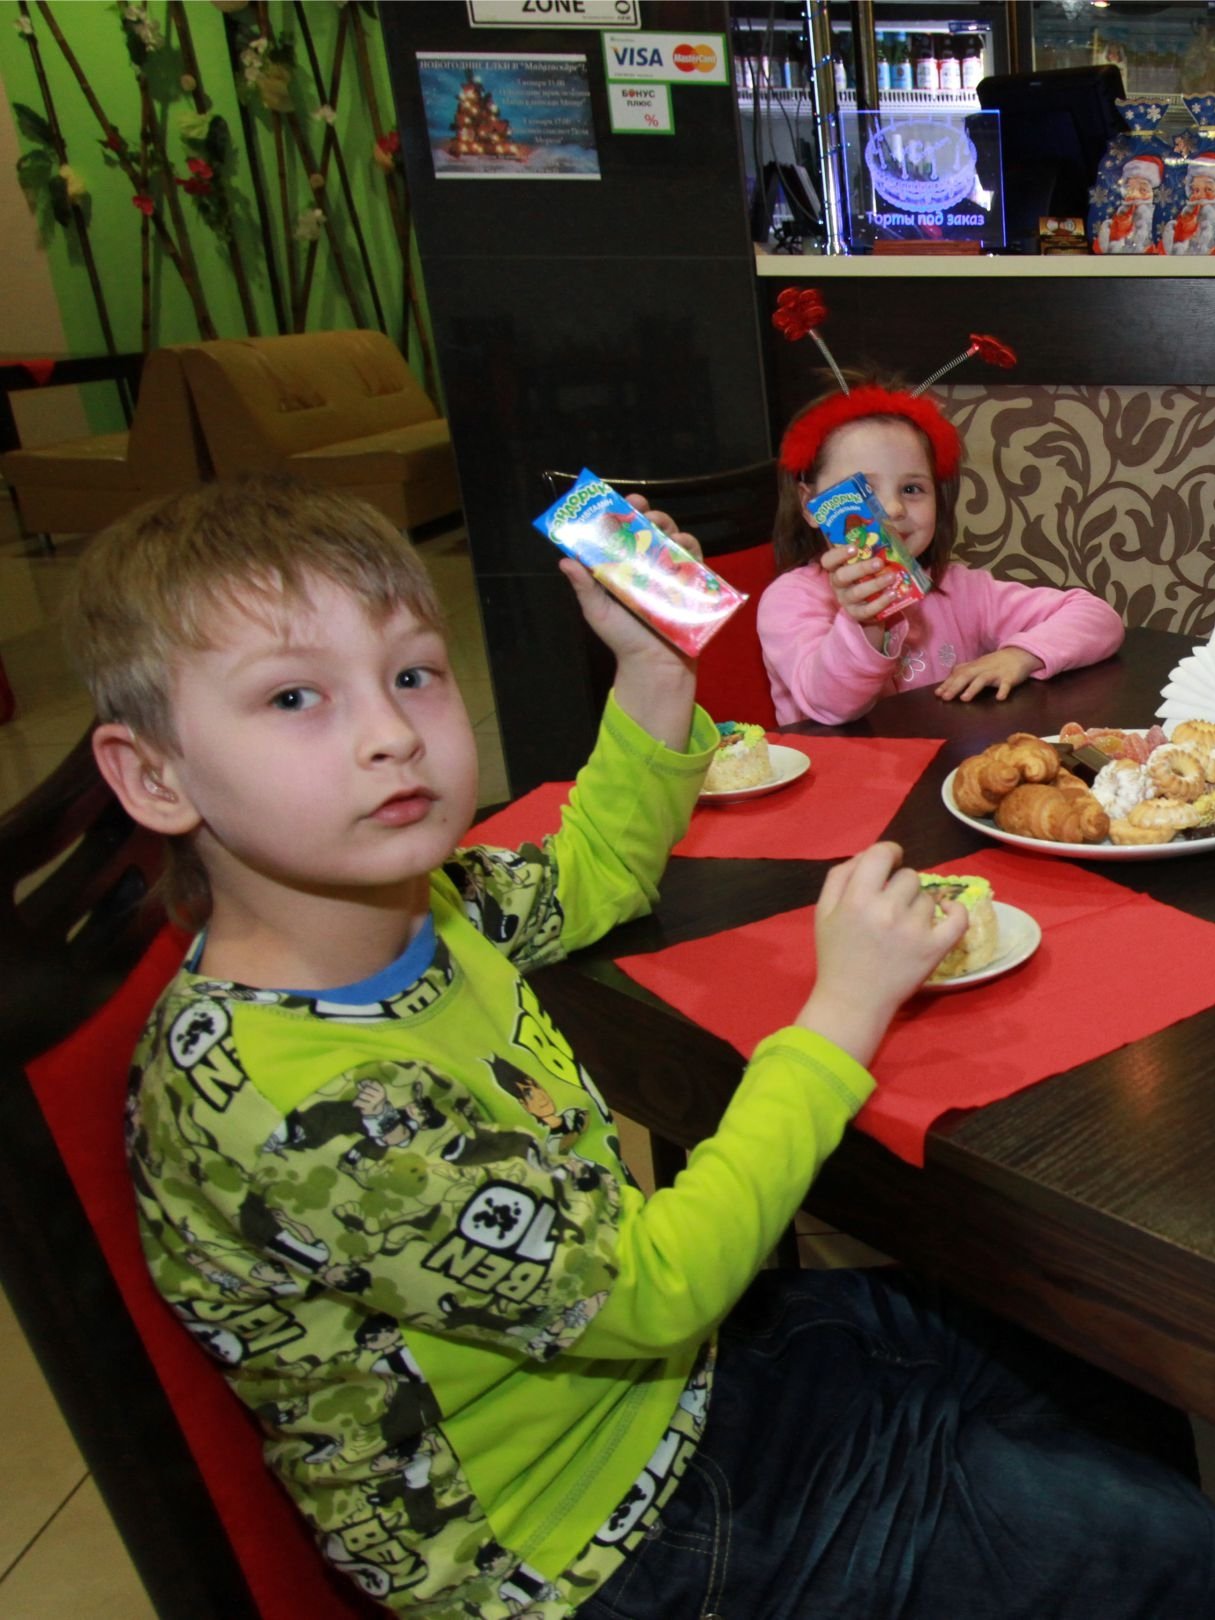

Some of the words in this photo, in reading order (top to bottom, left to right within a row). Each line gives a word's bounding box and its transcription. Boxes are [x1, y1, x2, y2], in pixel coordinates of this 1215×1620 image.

[522, 0, 586, 13] ZONE
[612, 47, 663, 67] VISA
[673, 53, 717, 63] MasterCard
[866, 211, 915, 228] Торты
[917, 210, 944, 226] под
[947, 213, 985, 226] заказ
[421, 1229, 551, 1305] BEN
[336, 1514, 430, 1593] BEN
